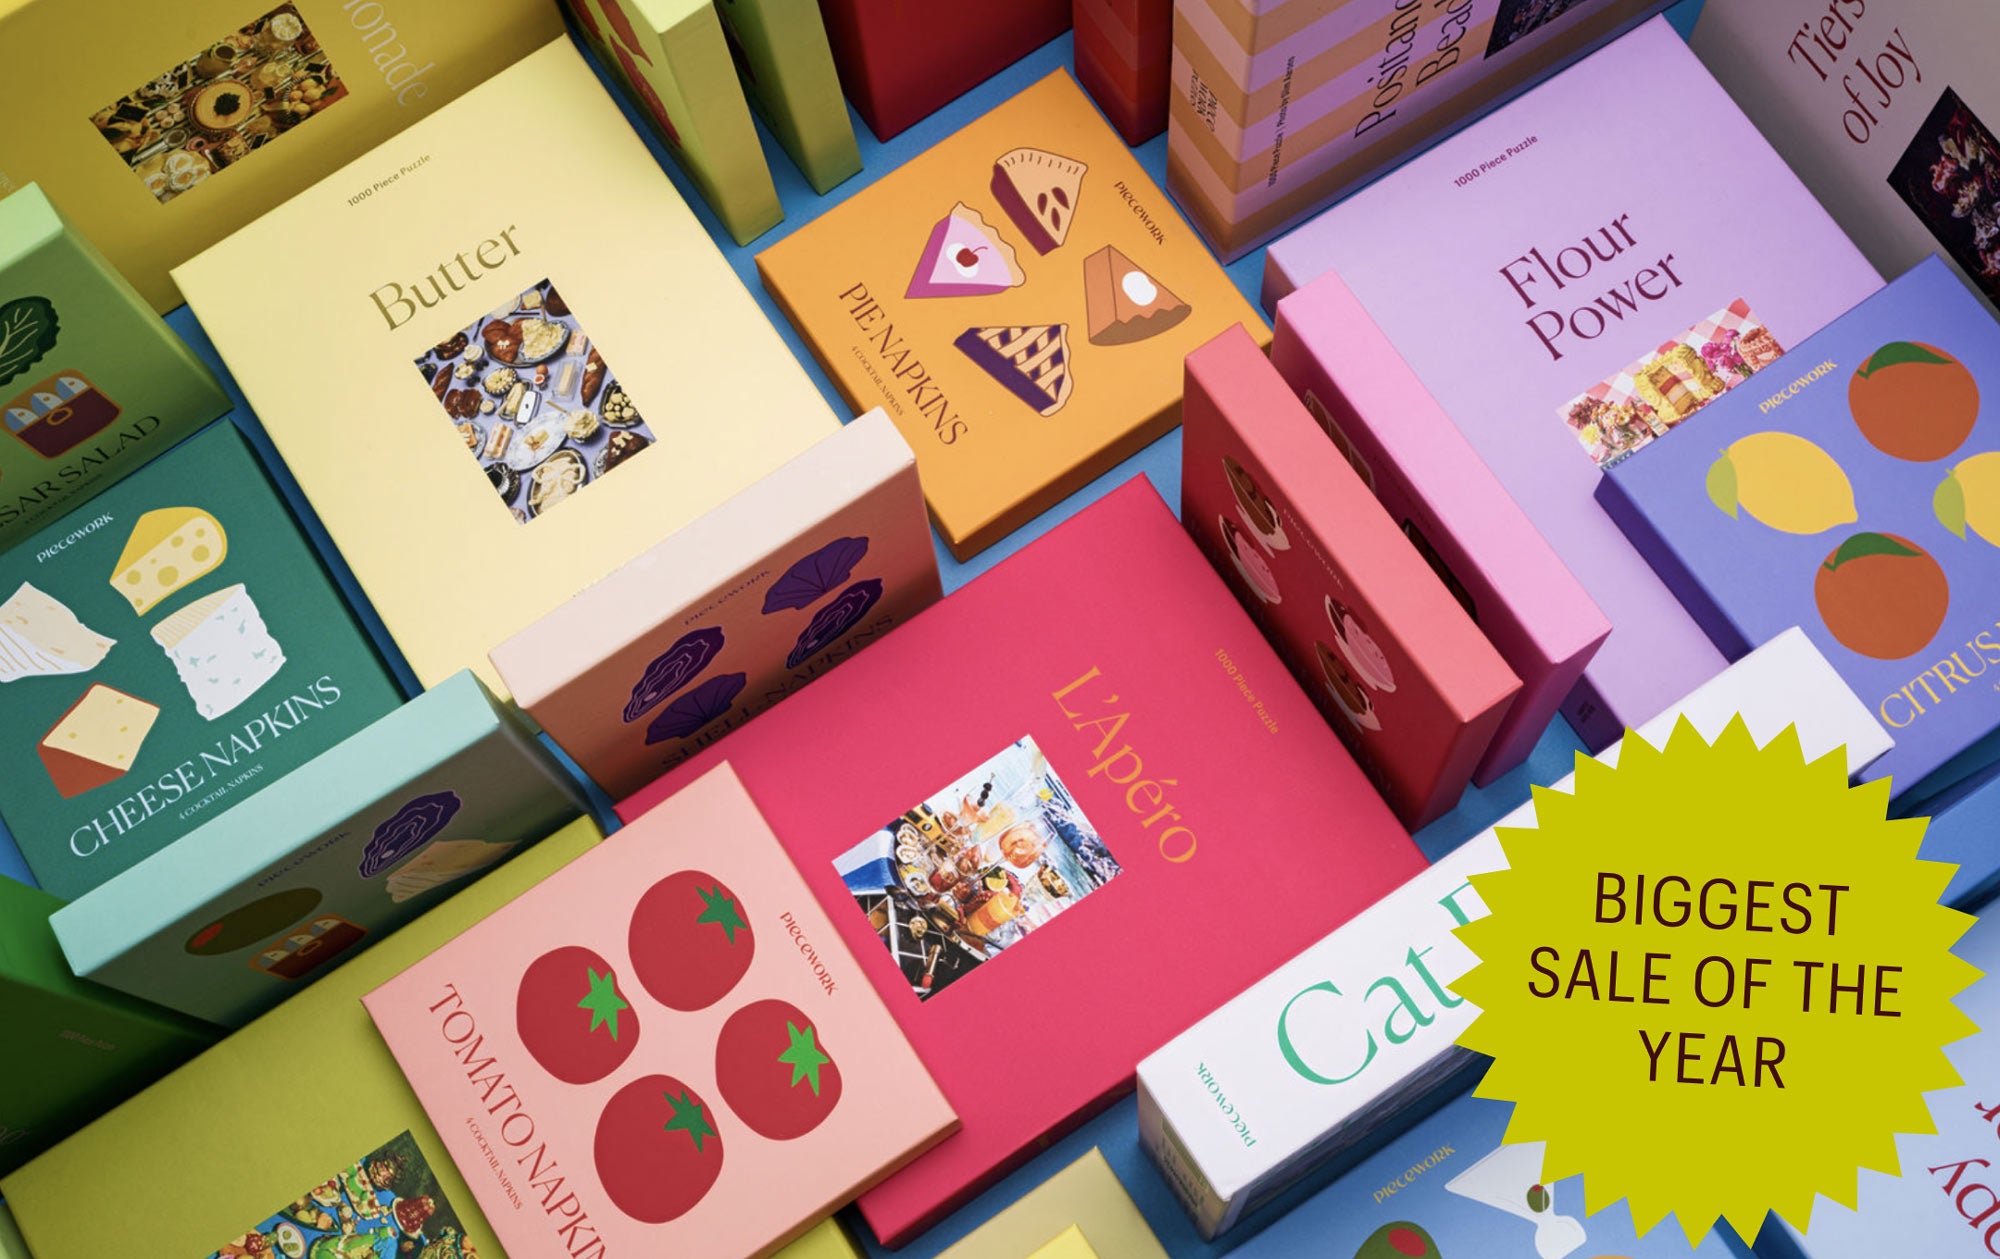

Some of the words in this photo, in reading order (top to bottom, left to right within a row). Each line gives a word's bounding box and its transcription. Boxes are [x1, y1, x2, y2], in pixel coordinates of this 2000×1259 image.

[1842, 74, 1879, 144] of
[1855, 27, 1922, 109] Joy
[347, 187, 373, 207] 1000
[372, 172, 401, 193] Piece
[400, 153, 432, 176] Puzzle
[1454, 169, 1480, 188] 1000
[1480, 154, 1507, 173] Piece
[1506, 136, 1538, 157] Puzzle
[369, 224, 521, 331] Butter
[1499, 213, 1637, 309] Flour
[1525, 253, 1683, 361] Power
[838, 282, 886, 332] PIE
[869, 324, 969, 445] NAPKINS
[0, 480, 61, 528] SAR
[58, 415, 161, 484] SALAD
[662, 706, 762, 767] SHELL
[765, 615, 894, 704] NAPKINS
[1215, 648, 1238, 675] 1000
[1233, 674, 1256, 702] Piece
[1252, 701, 1279, 735] Puzzle
[1880, 631, 2000, 729] CITRUS
[69, 761, 204, 857] CHEESE
[199, 675, 342, 778] NAPKINS
[184, 786, 228, 817] COCKTAIL
[226, 764, 264, 790] NAPKINS
[1278, 946, 1465, 1085] Cat
[428, 983, 535, 1147] TOMATO
[469, 1123, 499, 1170] COCKTAIL
[497, 1166, 524, 1211] NAPKINS
